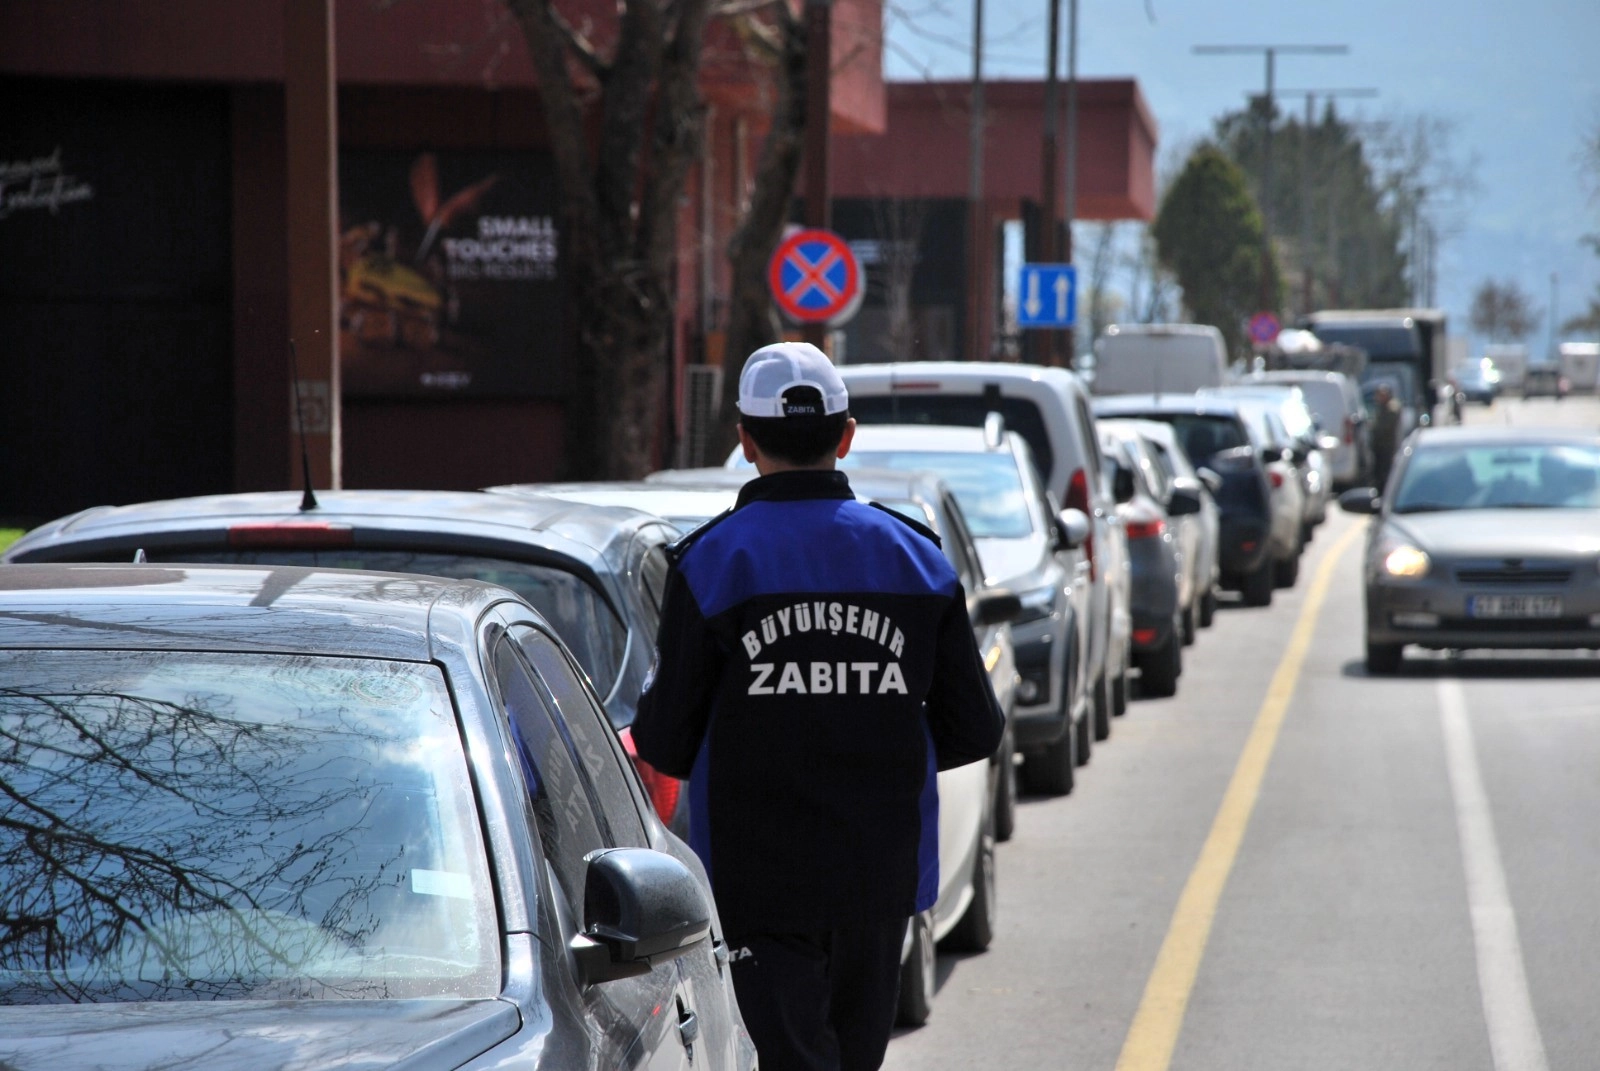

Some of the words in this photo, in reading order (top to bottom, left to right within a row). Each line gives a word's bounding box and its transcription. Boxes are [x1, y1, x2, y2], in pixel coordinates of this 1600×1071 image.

[478, 217, 554, 237] SMALL
[444, 239, 557, 261] TOUCHES
[787, 405, 816, 414] ZABITA
[741, 601, 905, 661] BÜYÜKŞEHİR
[747, 661, 909, 696] ZABITA
